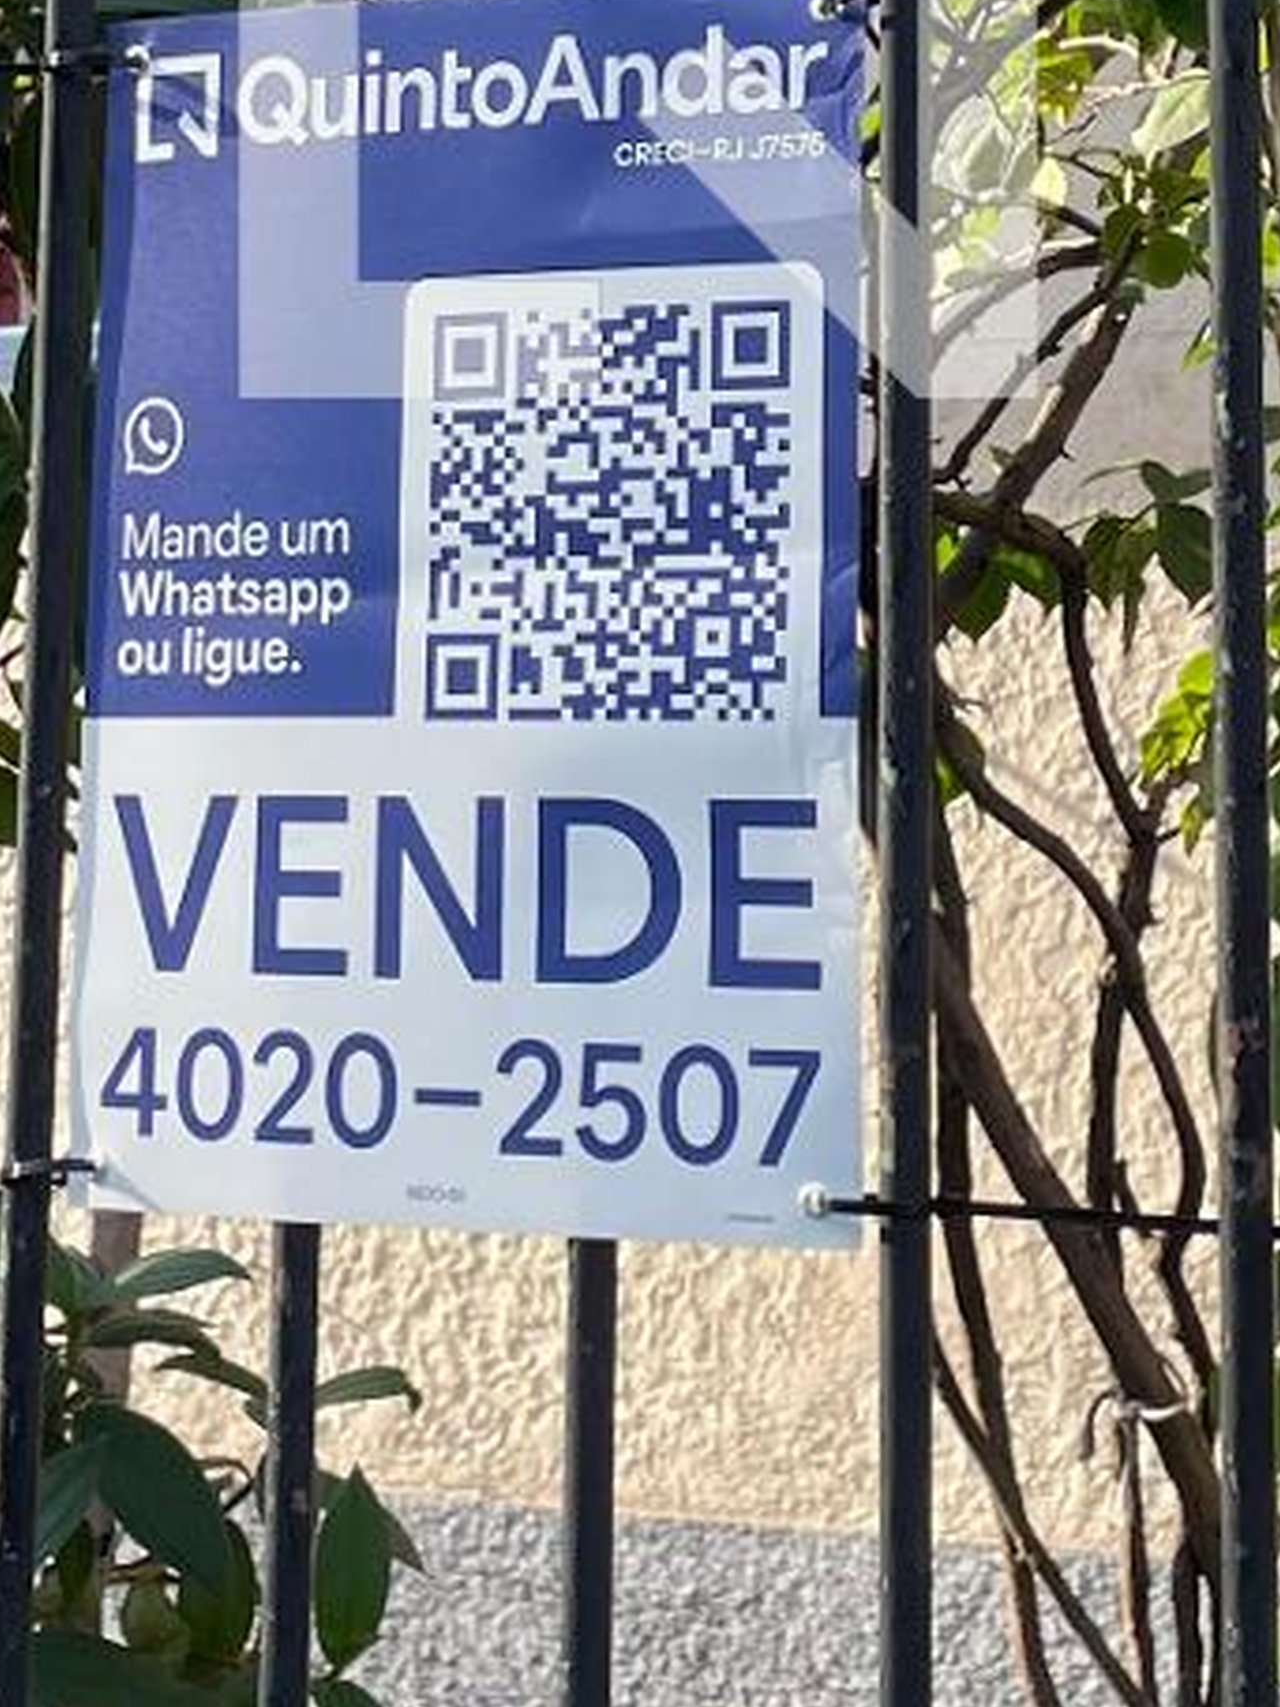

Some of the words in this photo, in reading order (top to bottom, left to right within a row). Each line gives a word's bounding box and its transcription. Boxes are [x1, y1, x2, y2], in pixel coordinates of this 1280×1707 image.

[237, 24, 829, 147] QuintoAndar
[122, 509, 269, 560] Mande
[281, 517, 350, 555] um
[118, 569, 351, 625] Whatsapp
[117, 639, 171, 675] ou
[182, 626, 302, 687] ligue.
[113, 795, 822, 990] VENDE
[99, 1026, 822, 1167] 4020-2507
